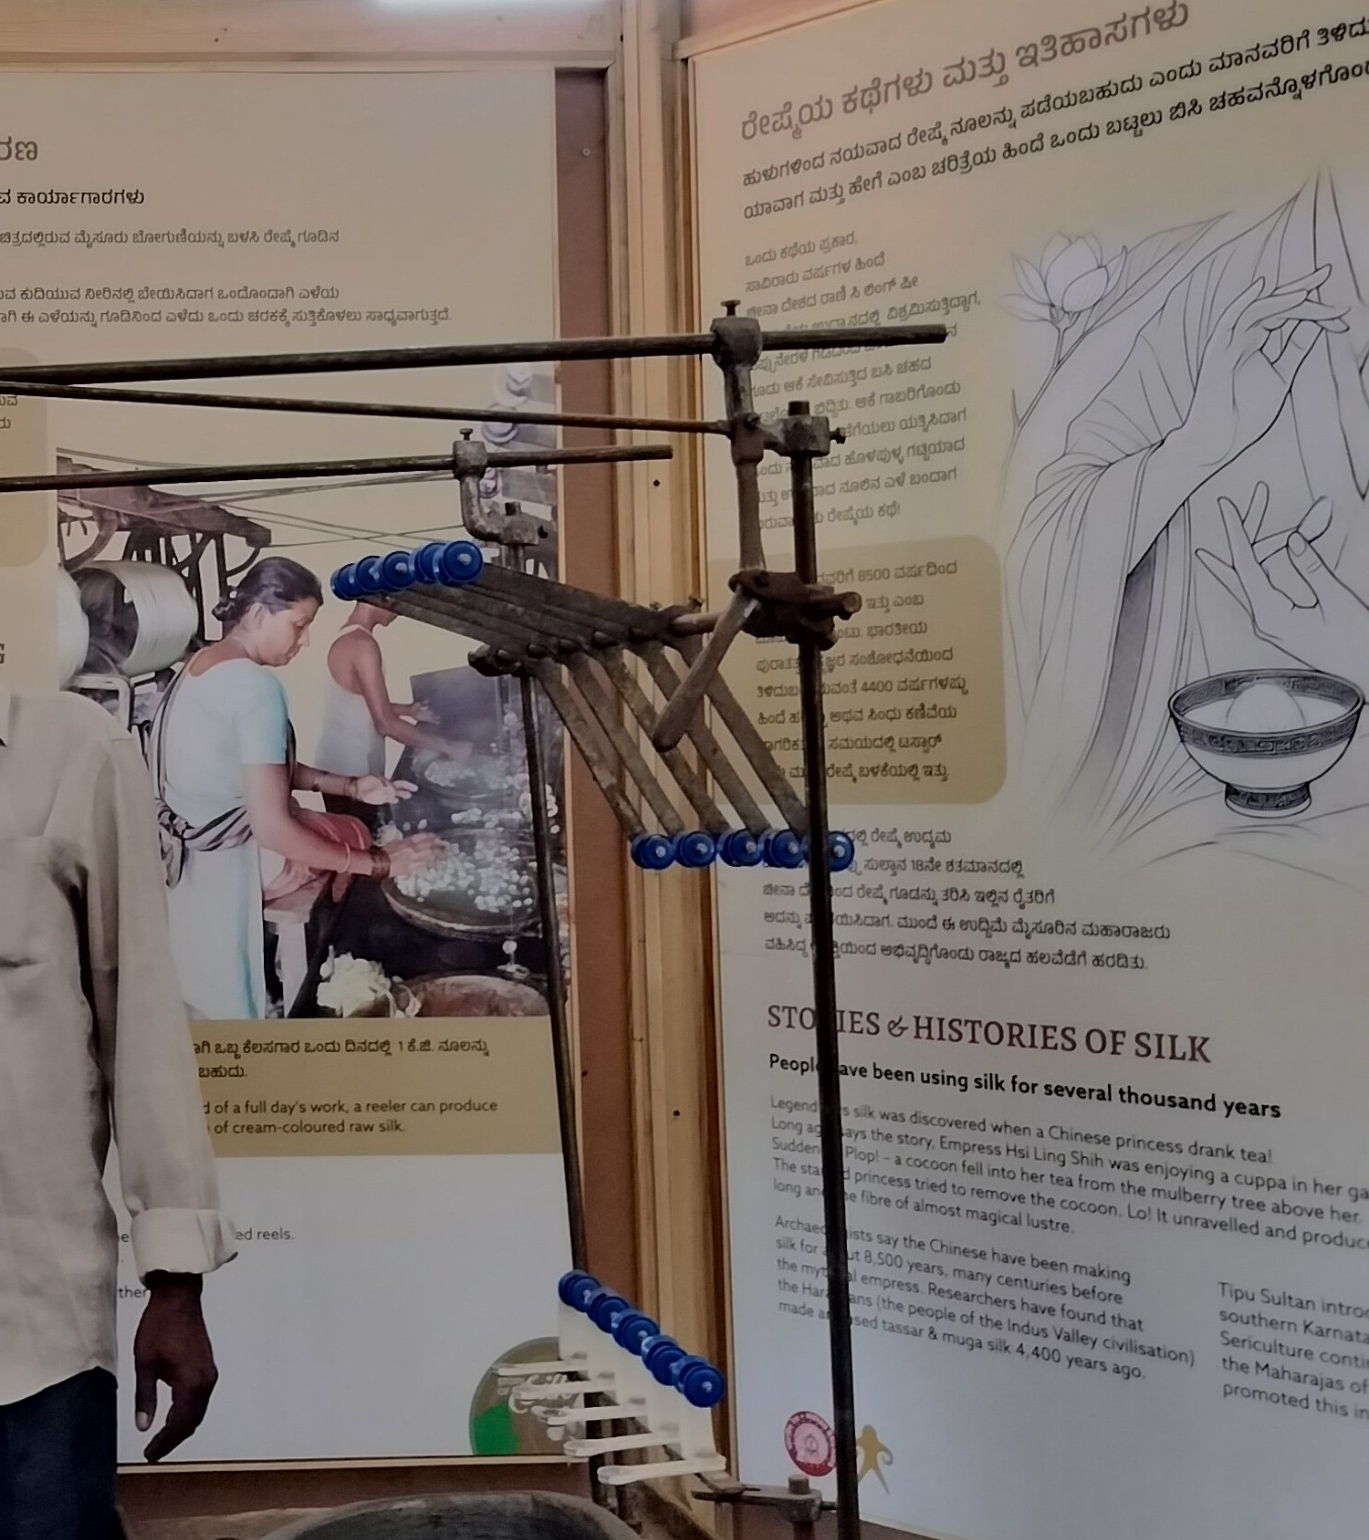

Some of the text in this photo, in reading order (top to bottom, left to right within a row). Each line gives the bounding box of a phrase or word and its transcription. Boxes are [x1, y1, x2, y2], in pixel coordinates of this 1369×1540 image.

[741, 0, 1189, 140] ರೇಷ್ಮೆಯ ಕಥೆಗಳು ಮತ್ತು ಇತಿಹಾಸಗಳು
[743, 152, 825, 186] ಹುಳುಗಳಿಂದ
[829, 132, 902, 166] ನಯವಾದ
[1021, 74, 1143, 120] ಪಡೆಯಬಹುದು
[1149, 59, 1202, 88] ಎಂದು
[1208, 28, 1311, 73] ಮಾನವರಿಗೆ
[743, 191, 805, 220] ಯಾವಾಗ
[809, 183, 846, 206] ಮತ್ತು
[848, 172, 883, 195] ಹೇಗೆ
[887, 164, 926, 186] ಎಂಬ
[1002, 132, 1045, 160] ಹಿಂದೆ
[1050, 123, 1100, 149] ಒಂದು
[1106, 108, 1163, 137] ಬಟ್ಟಲು
[1169, 99, 1203, 121] ಬಿಸಿ
[861, 680, 893, 693] 4400
[768, 1005, 1211, 1063] STOIES & HISTORIES OF SILK
[214, 1100, 229, 1114] of
[233, 1104, 240, 1114] a
[245, 1100, 266, 1114] full
[310, 1099, 349, 1115] work,
[354, 1103, 362, 1113] a
[366, 1098, 406, 1112] reeler
[410, 1102, 435, 1112] can
[440, 1098, 498, 1115] produce
[839, 1064, 867, 1079] ave
[873, 1062, 915, 1082] been
[921, 1069, 968, 1092] using
[974, 1072, 1005, 1092] silk
[1011, 1075, 1038, 1094] for
[1044, 1083, 1112, 1102] several
[1119, 1086, 1216, 1112] thousand
[1223, 1101, 1281, 1118] years
[214, 1120, 229, 1134] of
[233, 1119, 345, 1134] cream-coloured
[349, 1122, 374, 1132] raw
[379, 1119, 406, 1132] silk.
[770, 1096, 818, 1115] Legend
[854, 1106, 875, 1119] silk
[879, 1111, 906, 1123] was
[910, 1111, 986, 1133] discovered
[991, 1120, 1031, 1136] when
[1036, 1128, 1044, 1138] a
[1048, 1125, 1111, 1146] Chinese
[1116, 1135, 1183, 1154] princess
[1188, 1140, 1235, 1159] drank
[1240, 1148, 1272, 1164] tea!
[771, 1117, 803, 1135] Long
[871, 1128, 893, 1143] the
[897, 1134, 935, 1151] story,
[940, 1135, 1002, 1158] Empress
[1006, 1144, 1029, 1159] Hsi
[1034, 1148, 1066, 1167] Ling
[1071, 1151, 1104, 1168] Shih
[1108, 1158, 1140, 1173] was
[1144, 1162, 1215, 1186] enjoying
[1220, 1172, 1229, 1183] a
[1234, 1174, 1287, 1193] cuppa
[1293, 1178, 1307, 1192] in
[1313, 1178, 1342, 1196] her
[256, 1226, 296, 1240] reels.
[776, 1237, 796, 1251] silk
[800, 1239, 818, 1254] for
[864, 1250, 903, 1269] 8,500
[907, 1260, 948, 1277] years,
[953, 1267, 992, 1286] many
[997, 1275, 1067, 1296] centuries
[1072, 1284, 1123, 1304] before
[877, 1234, 899, 1250] say
[903, 1236, 925, 1251] the
[930, 1239, 987, 1260] Chinese
[992, 1248, 1026, 1266] have
[1031, 1253, 1068, 1272] been
[1073, 1263, 1131, 1286] making
[1218, 1281, 1255, 1303] Tipu
[1260, 1288, 1316, 1311] Sultan
[1219, 1309, 1297, 1333] southern
[1220, 1330, 1314, 1361] Sericulture
[1222, 1355, 1369, 1394] the Maharajas of
[1223, 1383, 1309, 1410] promoted
[1315, 1396, 1348, 1417] this
